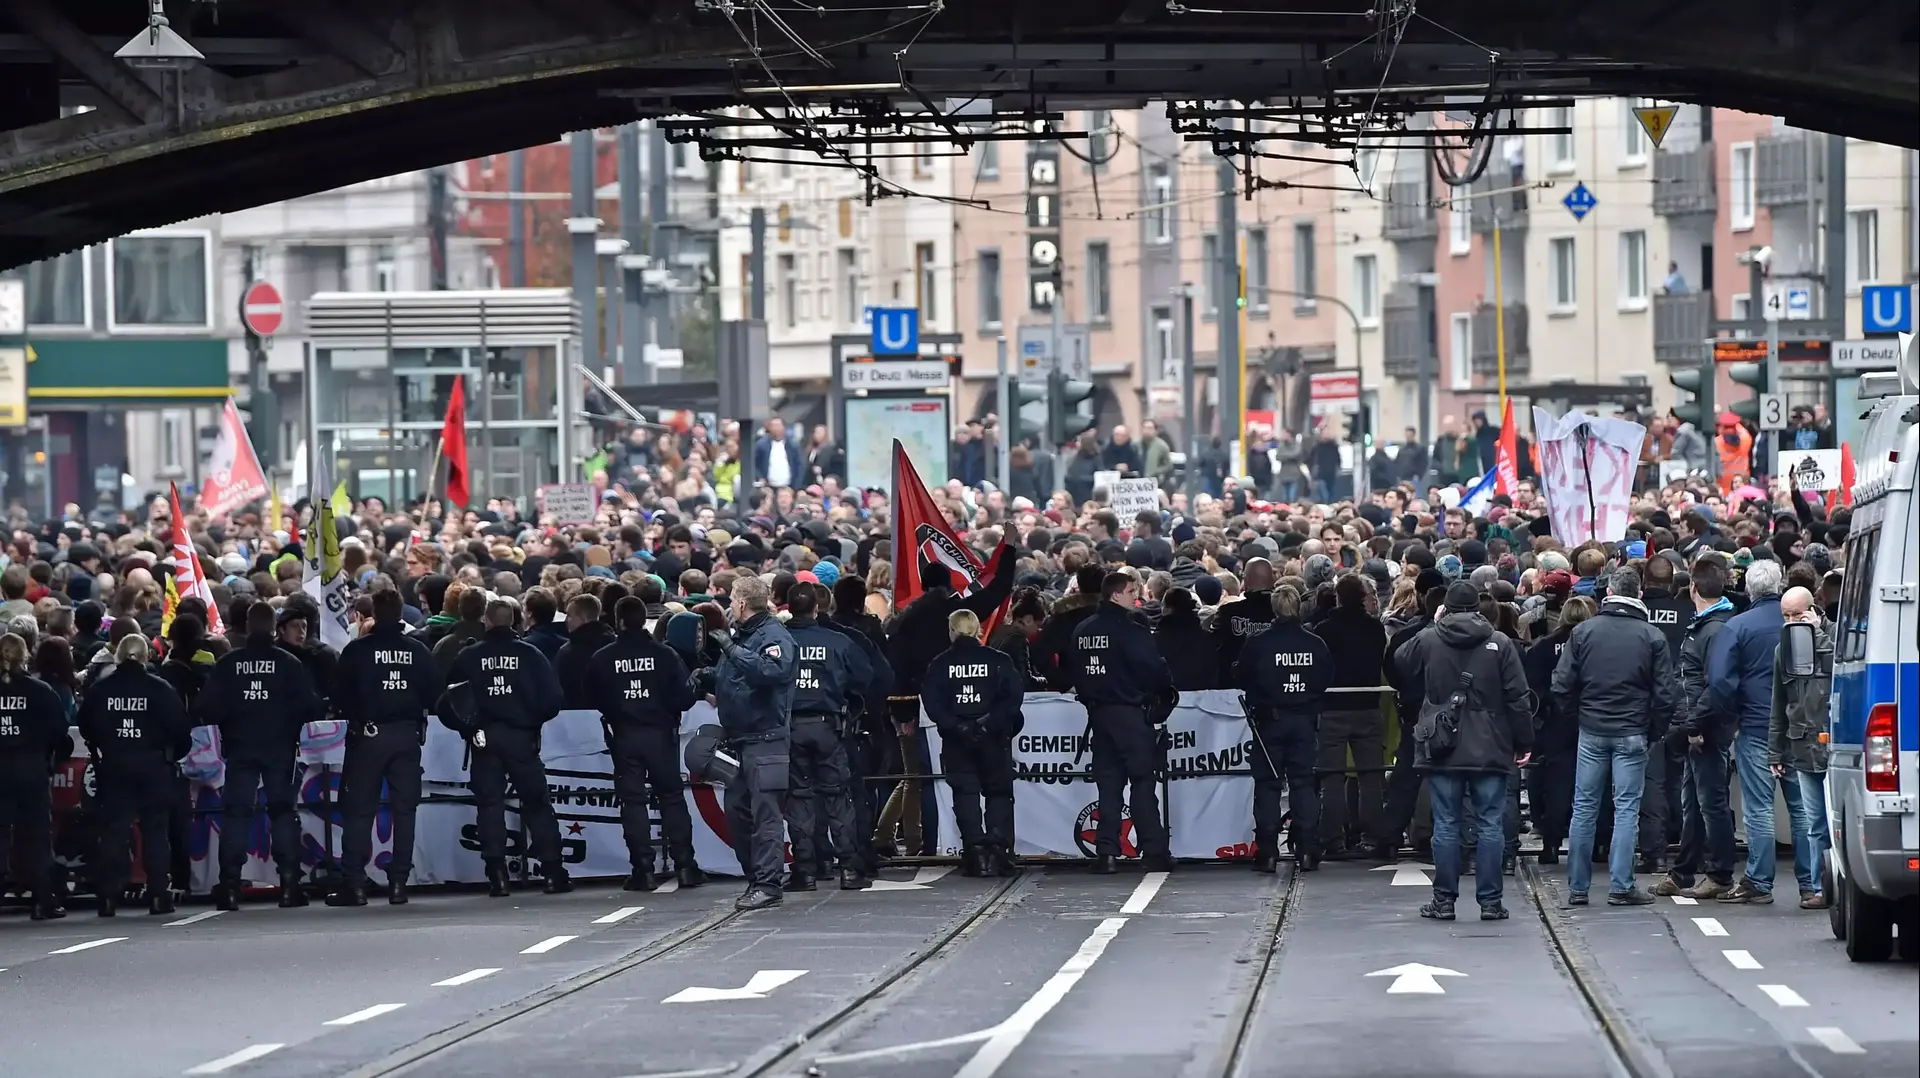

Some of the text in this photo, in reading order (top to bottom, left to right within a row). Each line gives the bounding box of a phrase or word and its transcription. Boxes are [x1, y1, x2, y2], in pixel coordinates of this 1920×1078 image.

[1768, 294, 1781, 312] 4
[1872, 290, 1902, 328] U
[880, 312, 911, 350] U
[1838, 349, 1853, 361] Bf
[1766, 398, 1782, 424] 3
[1648, 609, 1678, 624] LIZEI
[1078, 635, 1109, 650] POLIZEI
[374, 650, 413, 665] POLIZEI
[799, 646, 827, 661] LIZEI
[481, 655, 519, 671] POLIZEI
[1090, 655, 1100, 665] NI
[1275, 652, 1313, 667] POLIZEI
[236, 660, 276, 675] POLIZEI
[614, 657, 655, 674] POLIZEI
[948, 663, 989, 679] POLIZEI
[1085, 664, 1107, 675] 7514
[389, 670, 401, 681] NI
[800, 668, 812, 679] NI
[1289, 673, 1300, 683] NI
[250, 680, 262, 691] NI
[382, 680, 408, 690] 7513
[493, 675, 505, 686] NI
[630, 679, 642, 689] NI
[487, 685, 513, 696] 7514
[962, 684, 974, 694] NI
[1282, 682, 1306, 693] 7512
[243, 690, 269, 700] 7513
[623, 688, 650, 700] 7514
[955, 693, 982, 704] 7514
[0, 696, 27, 710] LIZEI
[107, 697, 148, 711] POLIZEI
[1, 716, 13, 726] NI
[122, 718, 134, 729] NI
[0, 725, 20, 736] 513
[116, 728, 142, 738] 7513
